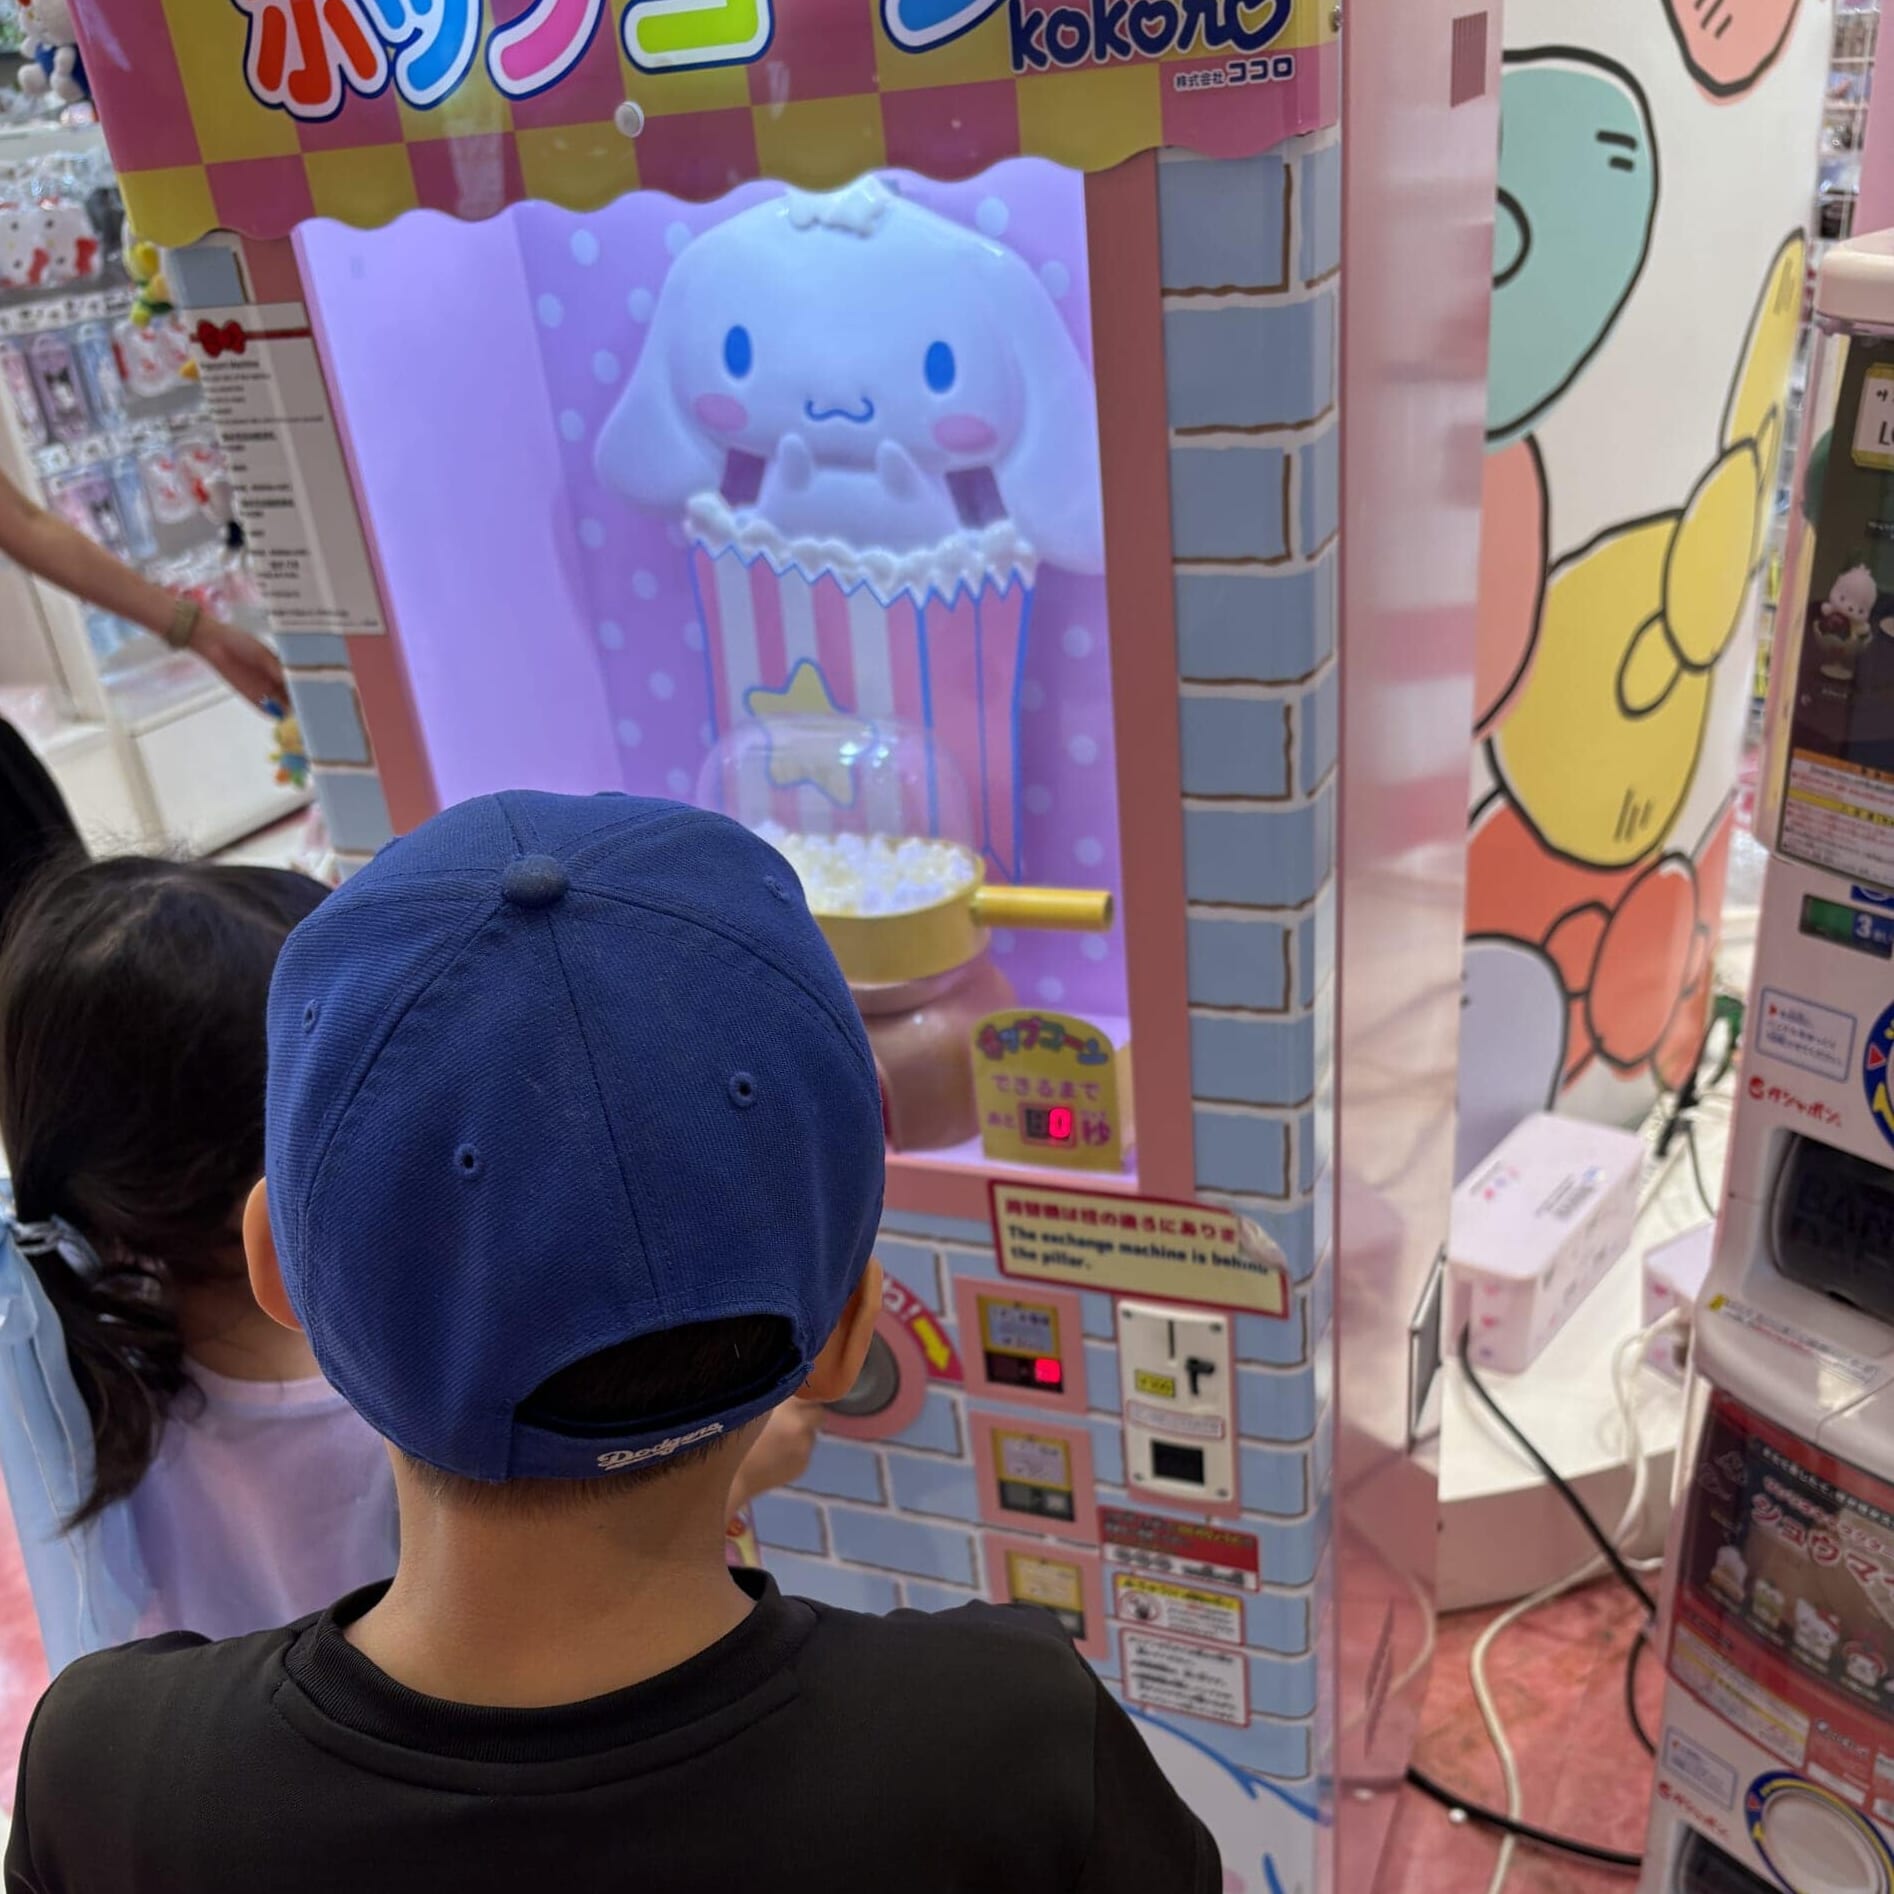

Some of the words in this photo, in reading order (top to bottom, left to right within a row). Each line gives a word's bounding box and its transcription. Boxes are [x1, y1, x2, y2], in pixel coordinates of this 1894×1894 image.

[1008, 1225, 1036, 1242] The
[1041, 1231, 1114, 1254] exchange
[1118, 1240, 1187, 1262] machine
[1191, 1247, 1207, 1265] is
[1010, 1246, 1036, 1262] the
[597, 1421, 725, 1471] Dodgers
